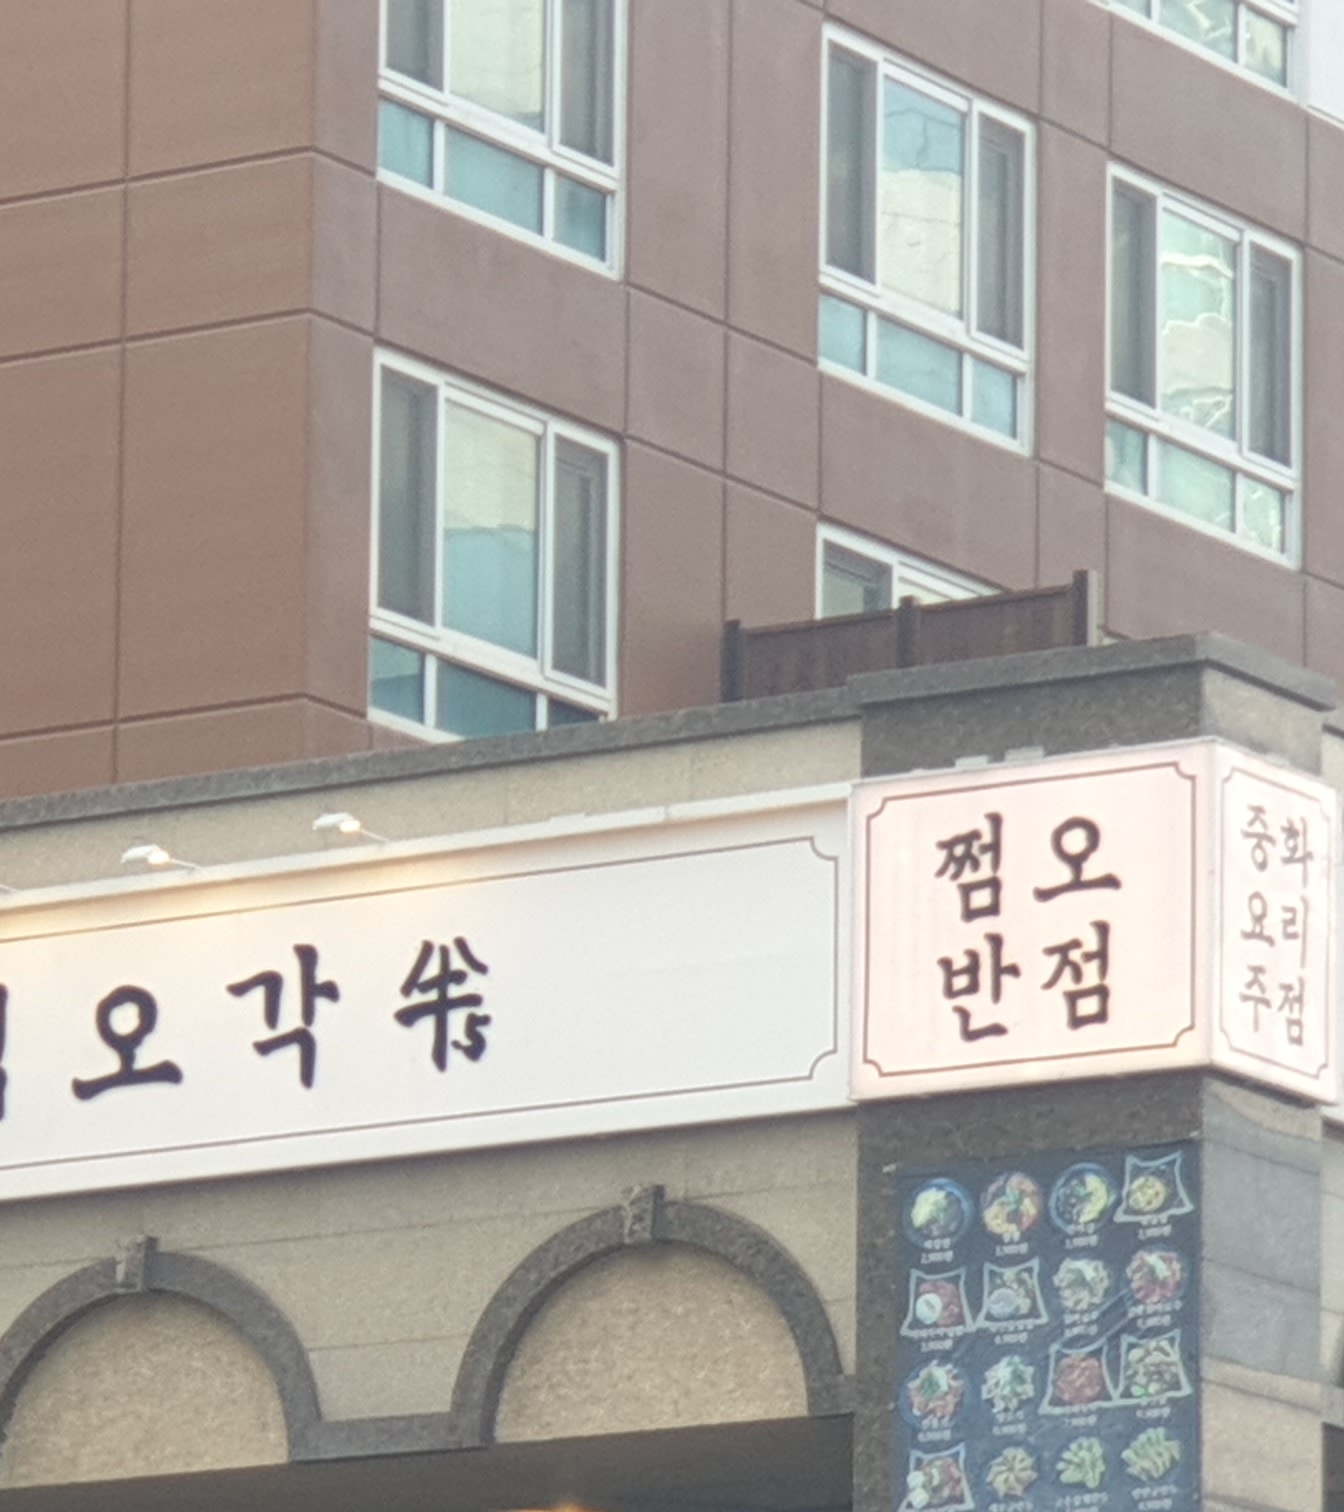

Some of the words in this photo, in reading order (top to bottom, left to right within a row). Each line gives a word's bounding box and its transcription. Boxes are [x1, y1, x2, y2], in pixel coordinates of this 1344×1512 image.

[933, 811, 1123, 923] 쩜오
[1238, 804, 1314, 890] 중화
[1238, 889, 1310, 970] 요리
[935, 919, 1112, 1043] 반점
[1238, 964, 1307, 1048] 주점
